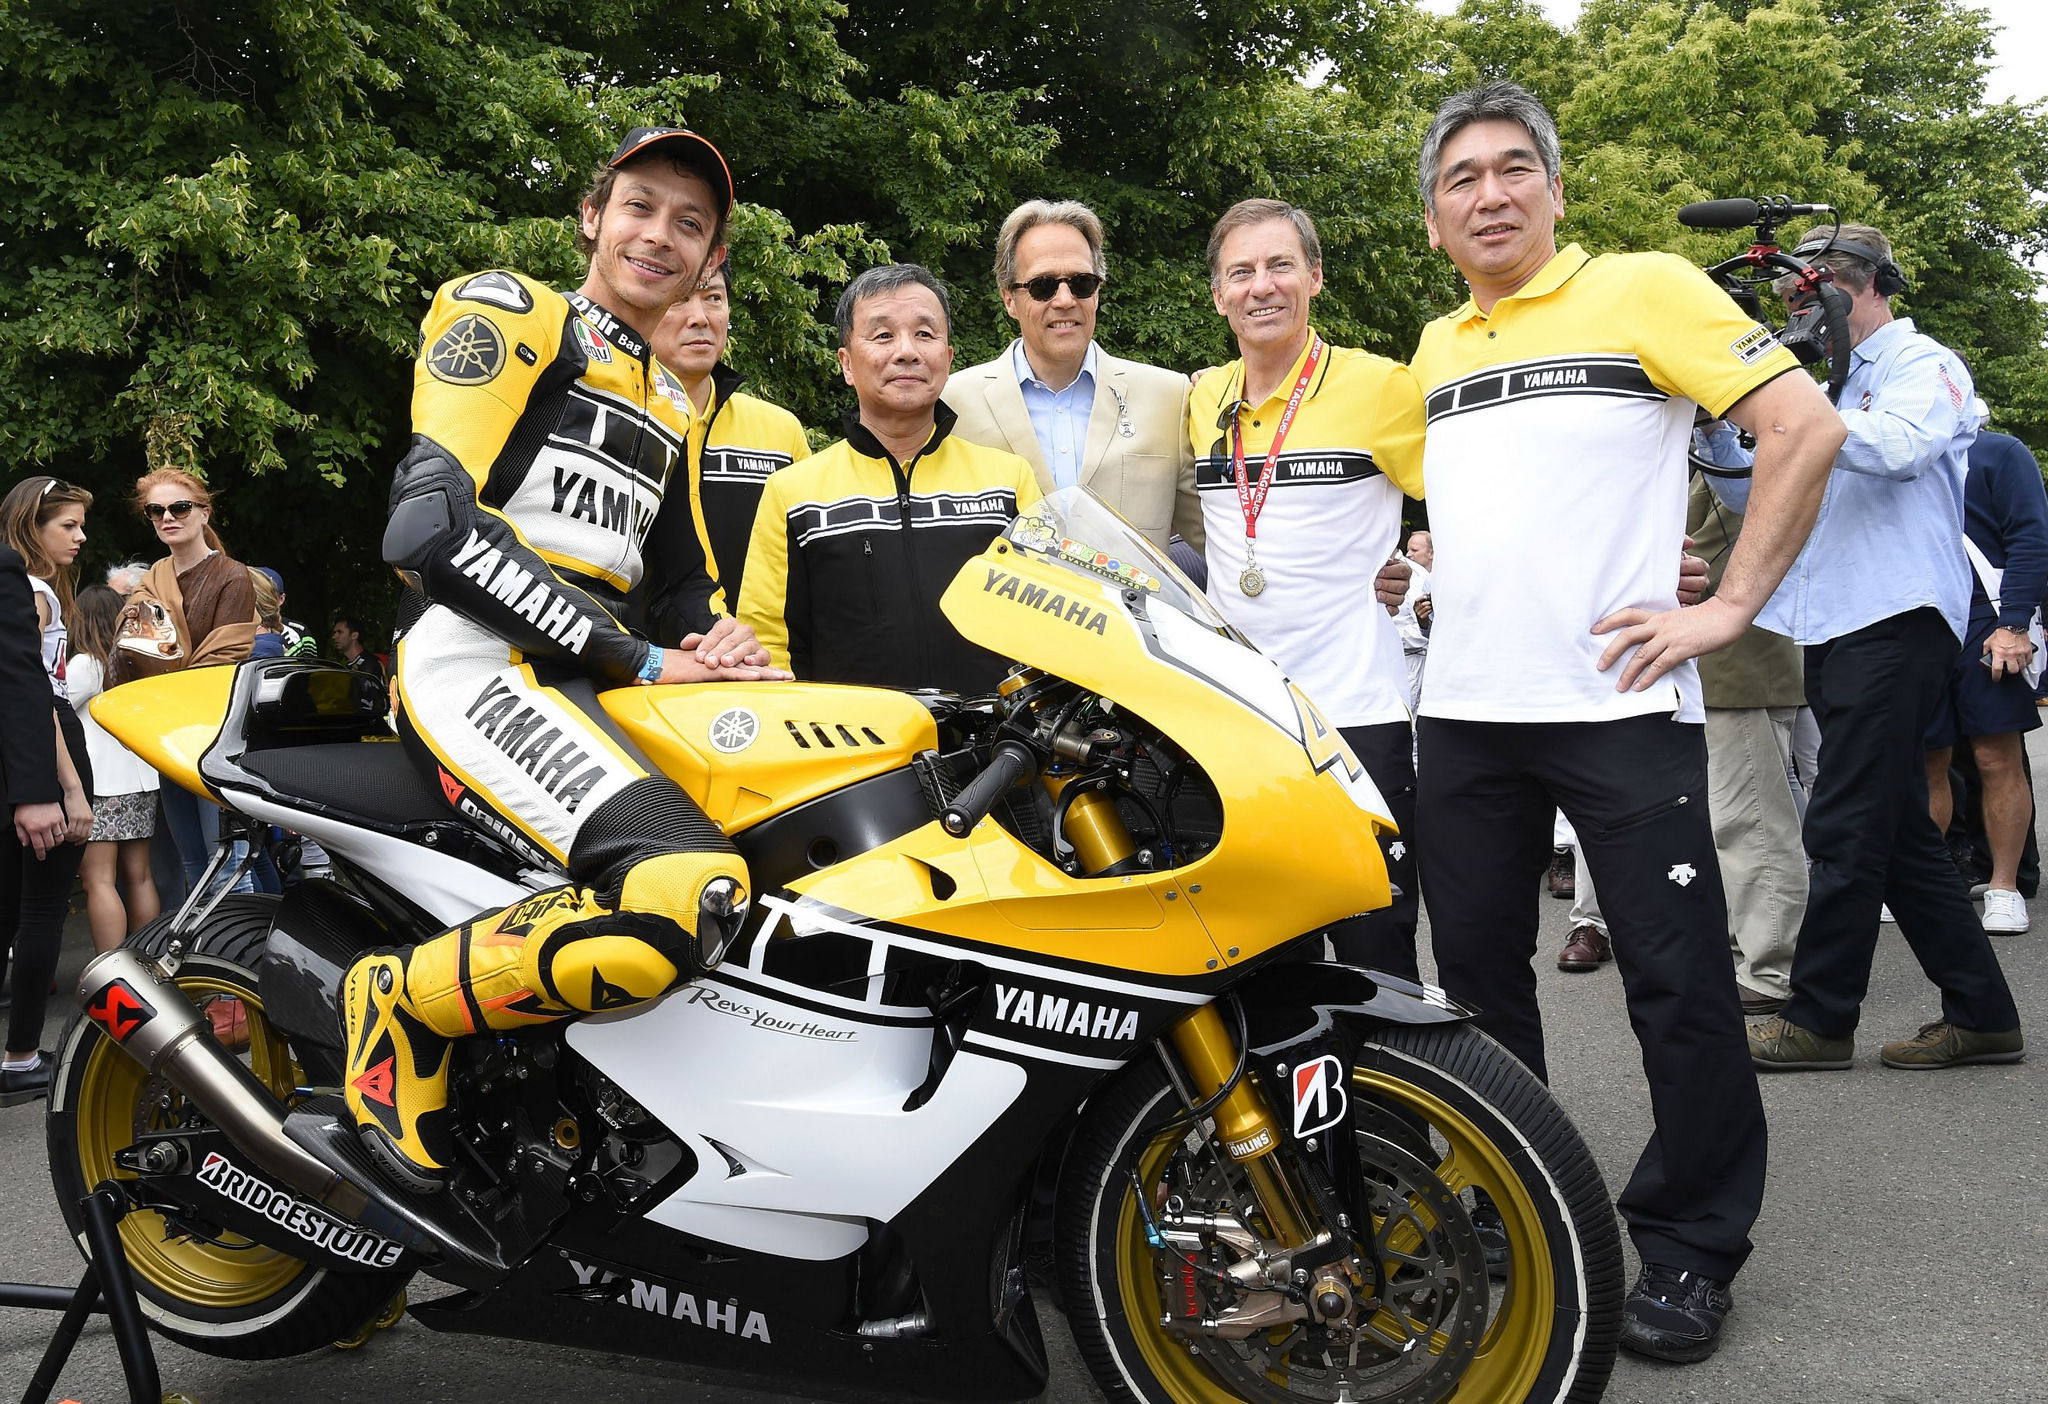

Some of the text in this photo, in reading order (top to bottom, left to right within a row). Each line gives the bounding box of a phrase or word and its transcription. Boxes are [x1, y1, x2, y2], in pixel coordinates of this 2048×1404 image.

[618, 333, 642, 356] Bag
[1735, 328, 1769, 350] YAMAHA
[1523, 369, 1588, 388] YAMAHA
[737, 458, 776, 473] YAMAHA
[1289, 461, 1344, 476] YAMAHA
[952, 499, 1005, 514] YAMAHA
[1060, 537, 1094, 560] THE
[450, 528, 593, 655] YAMAHA
[983, 569, 1108, 635] YAMAHA
[465, 676, 607, 815] YAMAHA
[687, 987, 857, 1040] Revs Your Heart
[995, 984, 1139, 1040] YAMAHA
[597, 1107, 622, 1129] EXEDY
[1229, 1131, 1270, 1156] ÖHLINS
[197, 1152, 403, 1267] BRIDGESTONE
